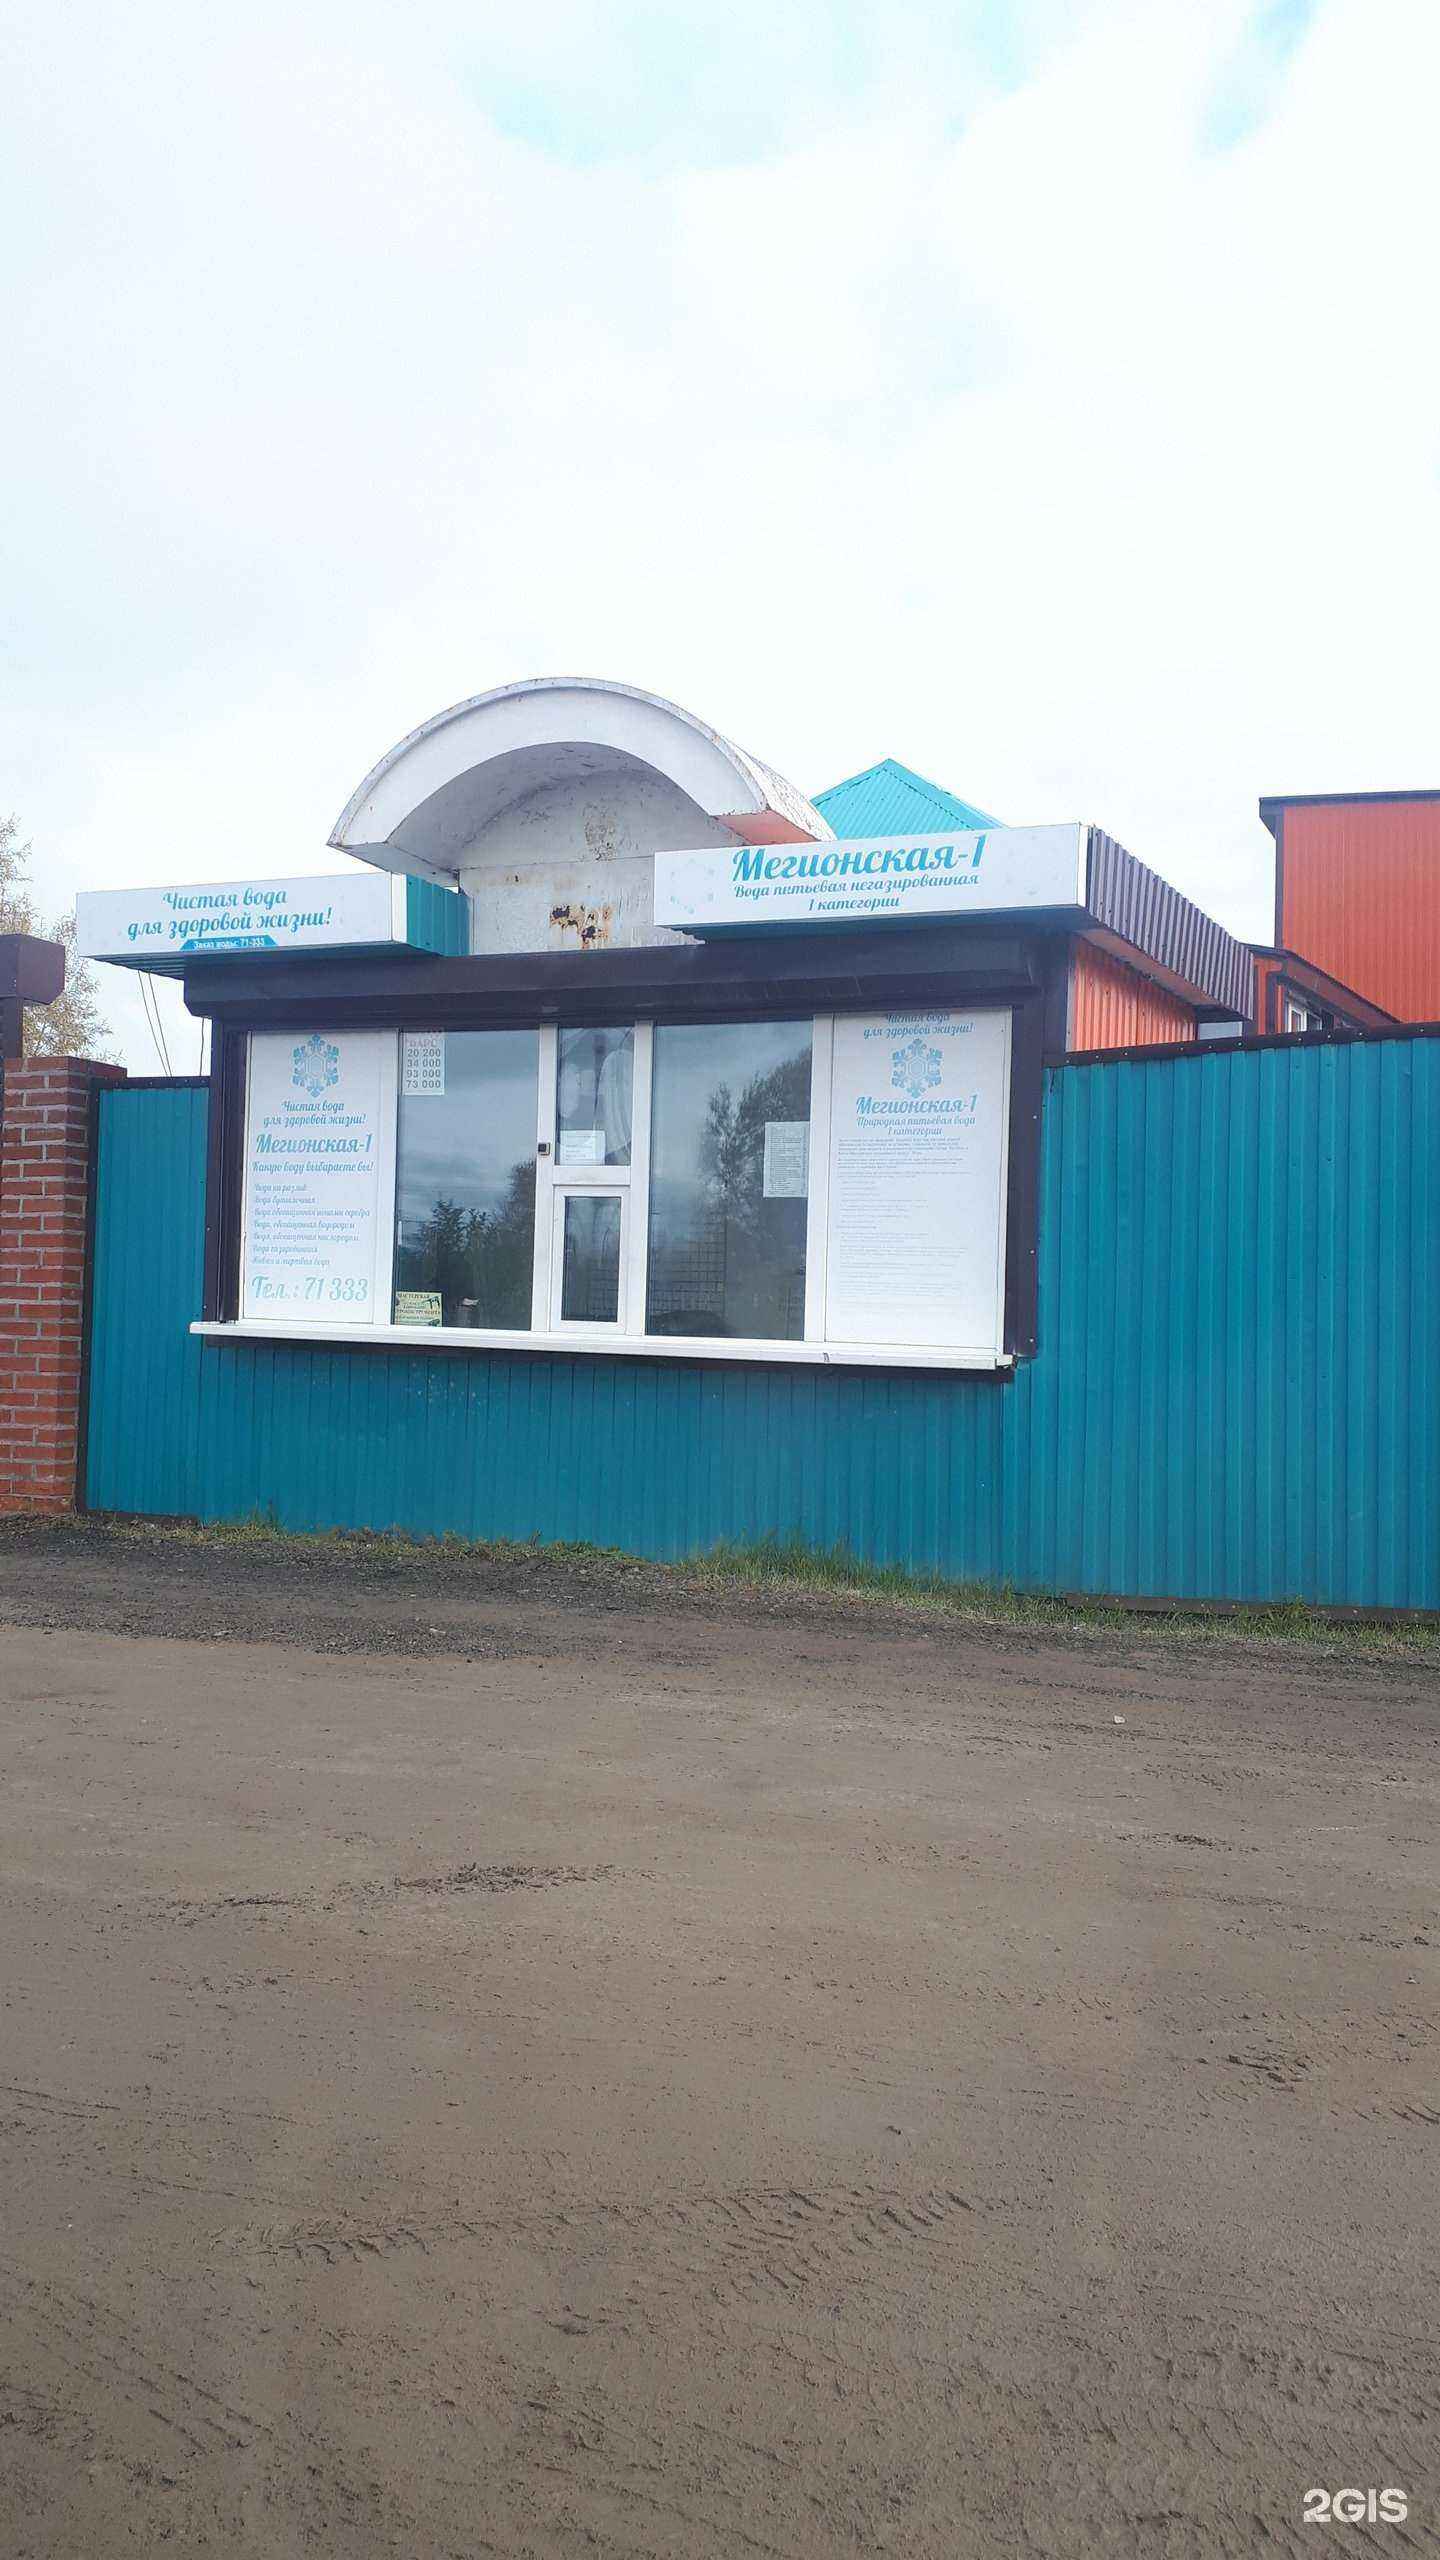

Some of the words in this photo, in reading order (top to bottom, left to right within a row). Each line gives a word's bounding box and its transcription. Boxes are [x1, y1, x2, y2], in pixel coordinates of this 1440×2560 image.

[732, 833, 989, 881] Мегионская-1
[734, 885, 770, 900] Вода
[773, 880, 848, 897] питьевая
[850, 874, 979, 893] негазированная
[163, 890, 239, 910] Чистая
[243, 888, 287, 909] вода
[817, 897, 900, 912] категории
[127, 921, 162, 941] для
[169, 912, 252, 939] здоровой
[256, 907, 333, 932] жизни!
[863, 1028, 882, 1040] для
[886, 1025, 931, 1039] здоровой
[933, 1022, 974, 1036] жизни!
[423, 1048, 441, 1058] 200
[422, 1069, 441, 1078] 000
[422, 1079, 441, 1089] 000
[281, 1101, 320, 1112] Чистая
[322, 1100, 344, 1113] вода
[856, 1094, 978, 1115] Мегионская-1
[263, 1116, 282, 1128] для
[285, 1114, 327, 1128] здоровой
[329, 1113, 366, 1127] жизни!
[857, 1117, 907, 1130] Природная
[908, 1115, 952, 1127] питьевая
[954, 1115, 976, 1128] вода
[256, 1133, 373, 1153] Мегионская-1
[304, 1277, 326, 1300] 71
[329, 1277, 368, 1301] 333
